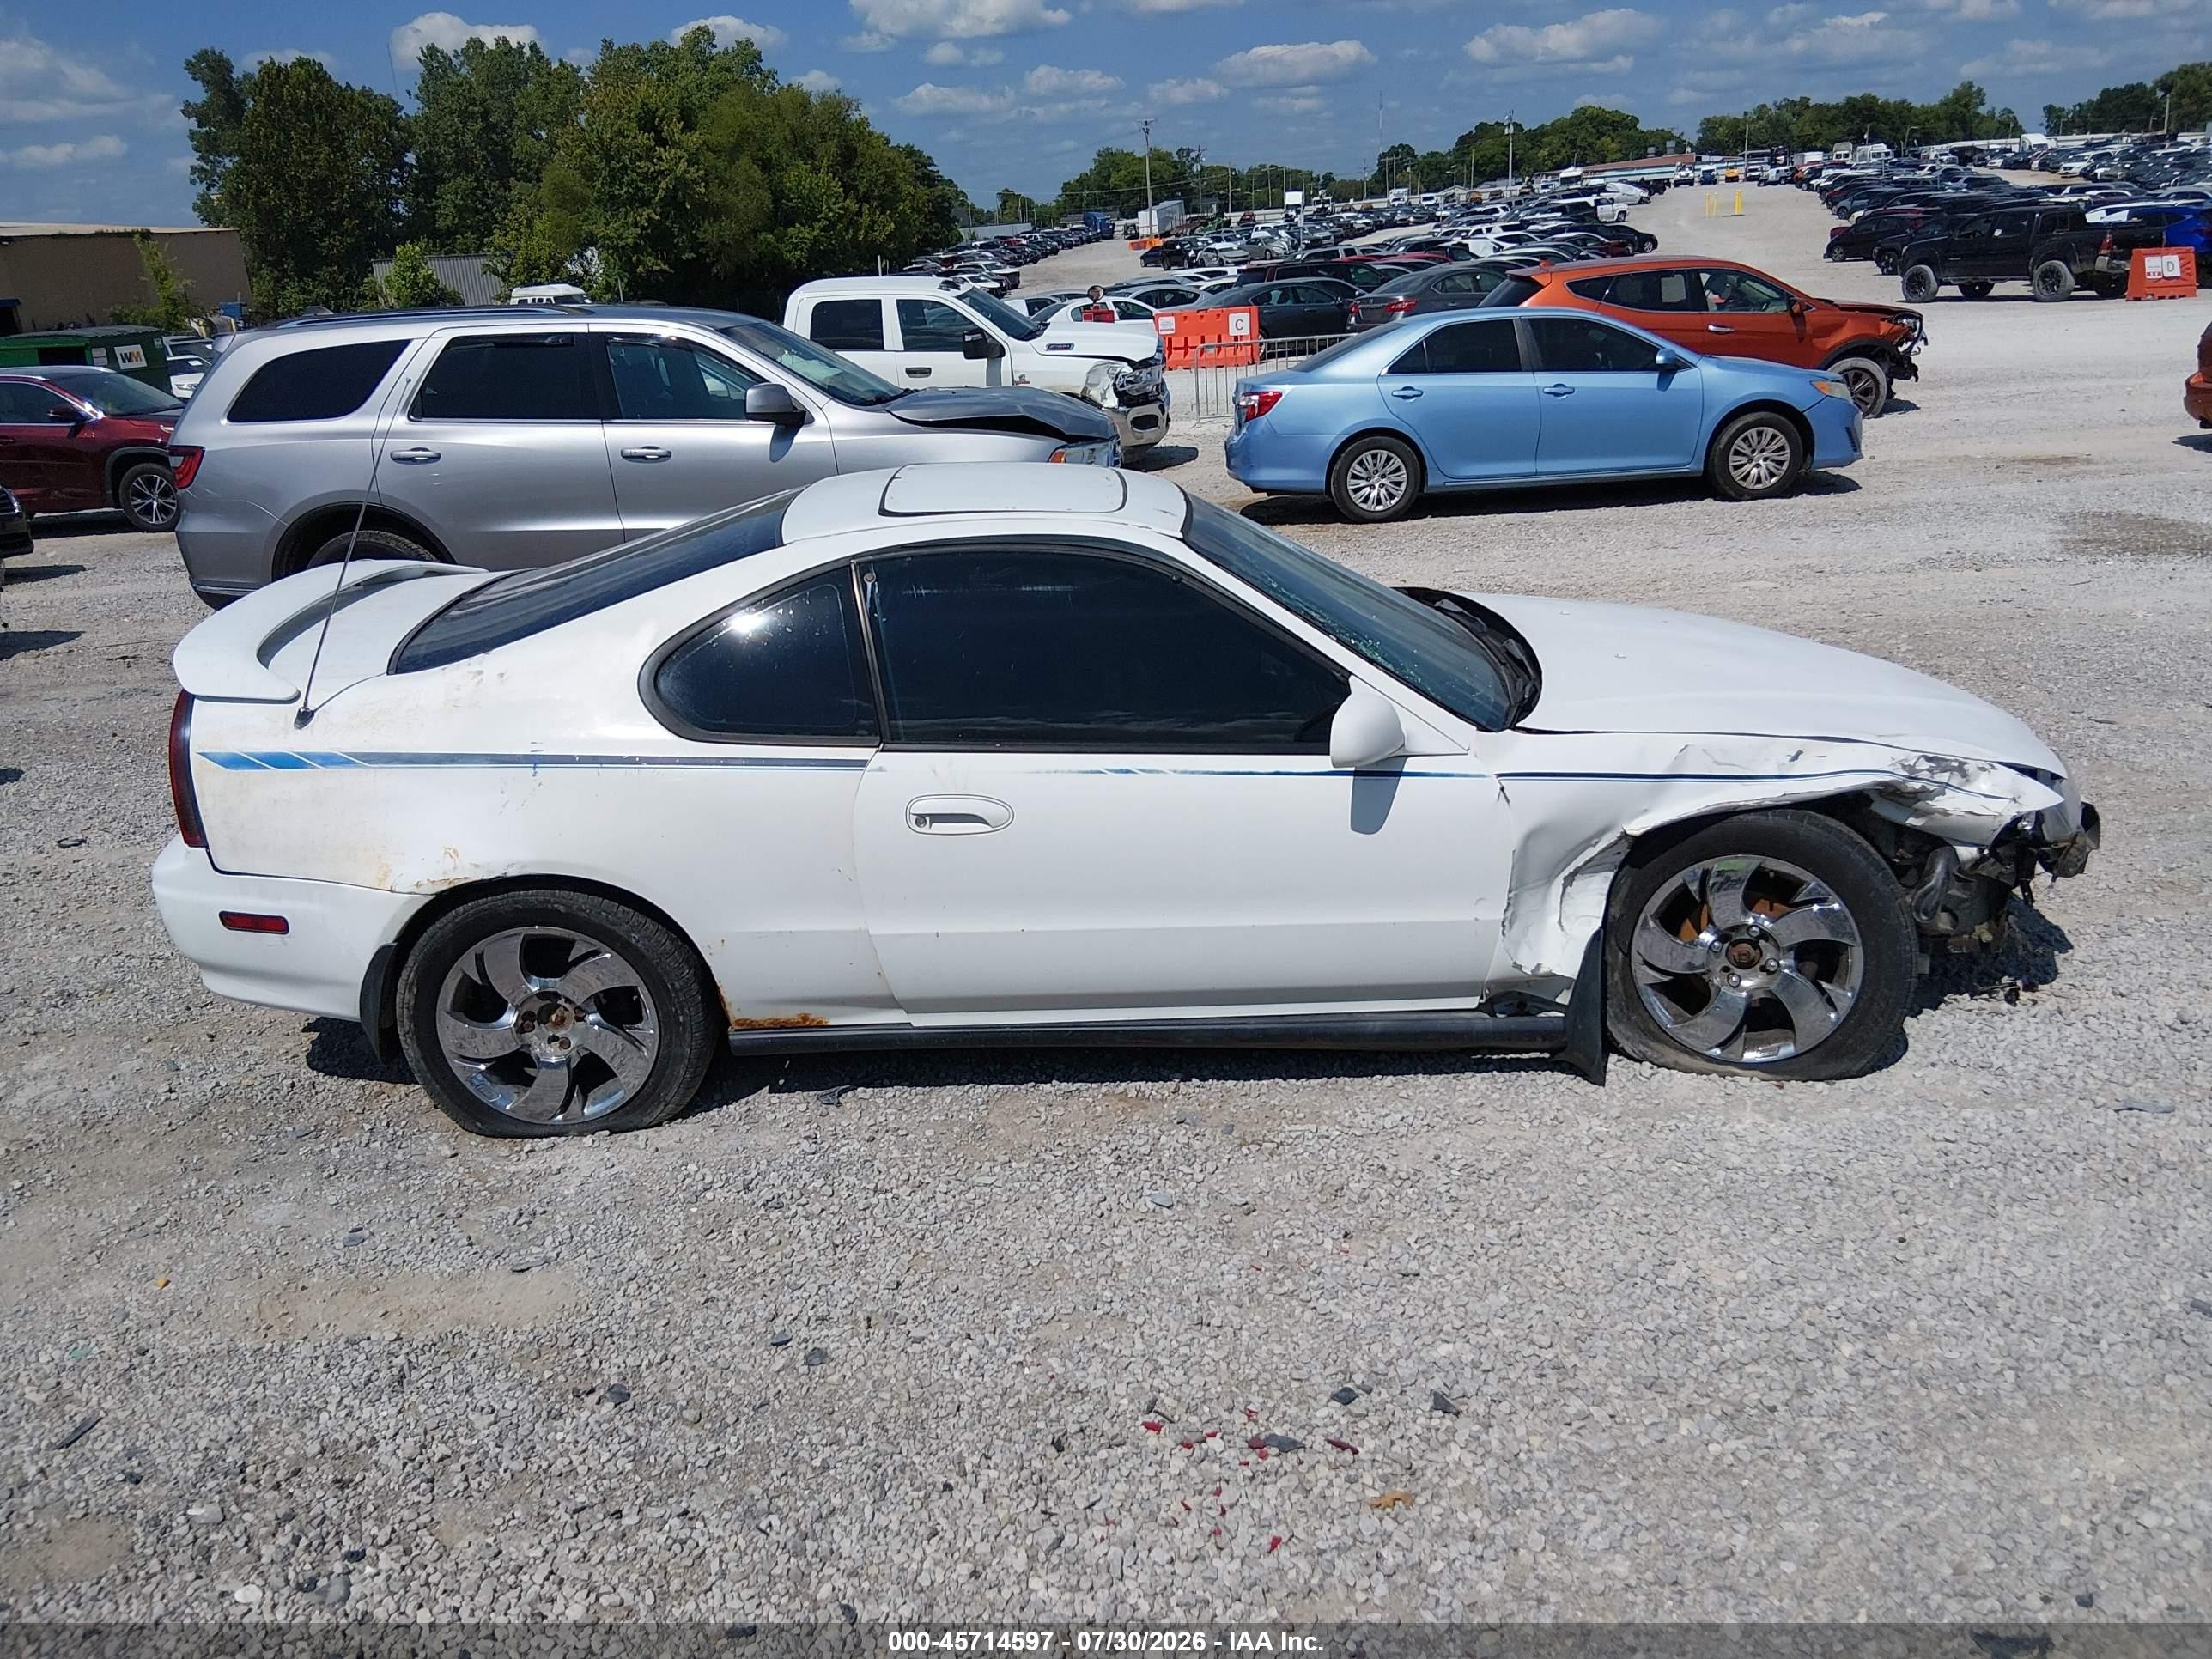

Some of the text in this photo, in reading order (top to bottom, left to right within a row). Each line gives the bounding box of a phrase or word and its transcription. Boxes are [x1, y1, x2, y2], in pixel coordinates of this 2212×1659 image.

[2166, 261, 2175, 272] D
[1235, 319, 1244, 331] C
[120, 350, 143, 364] WM
